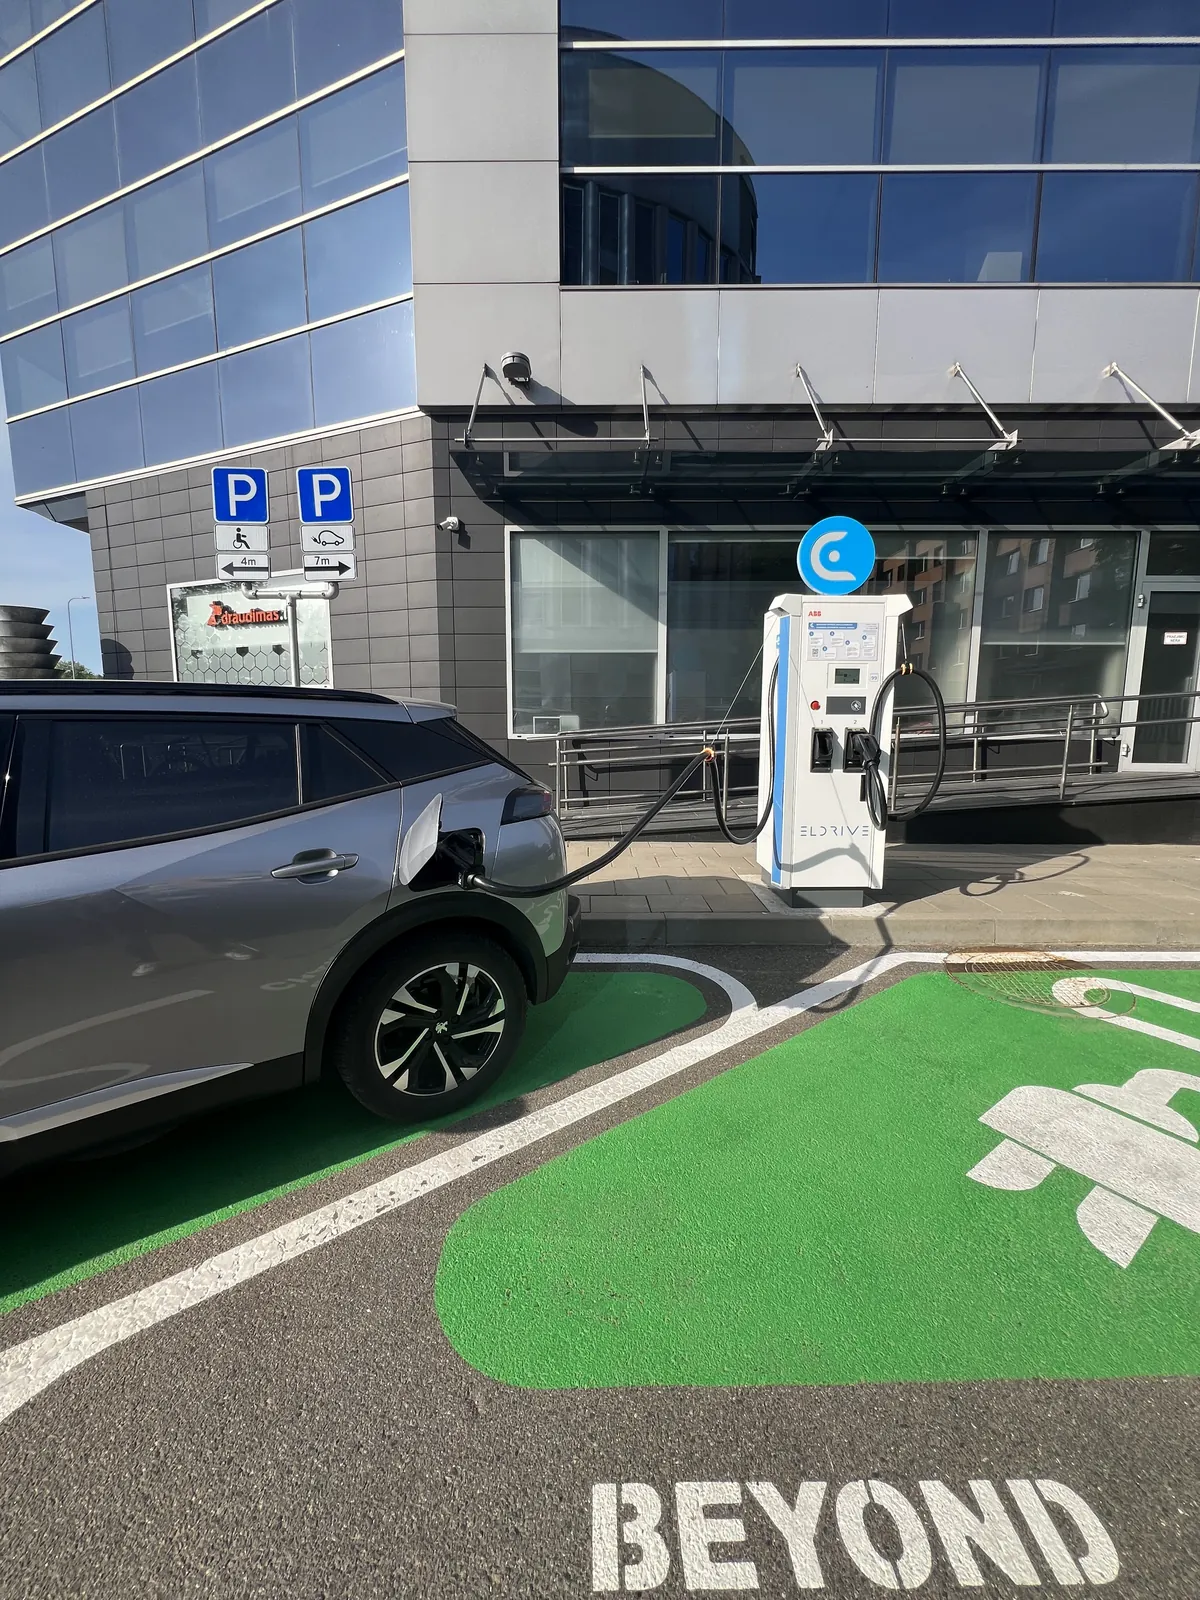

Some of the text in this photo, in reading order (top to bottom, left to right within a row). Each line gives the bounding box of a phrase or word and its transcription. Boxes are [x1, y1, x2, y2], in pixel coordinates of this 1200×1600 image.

[227, 473, 258, 517] P
[312, 473, 342, 517] P
[240, 556, 257, 566] 4m
[314, 556, 330, 565] 7m
[221, 606, 288, 625] draudimas.l
[800, 825, 869, 837] ELDRIVE
[590, 1478, 1120, 1592] BEYOND
